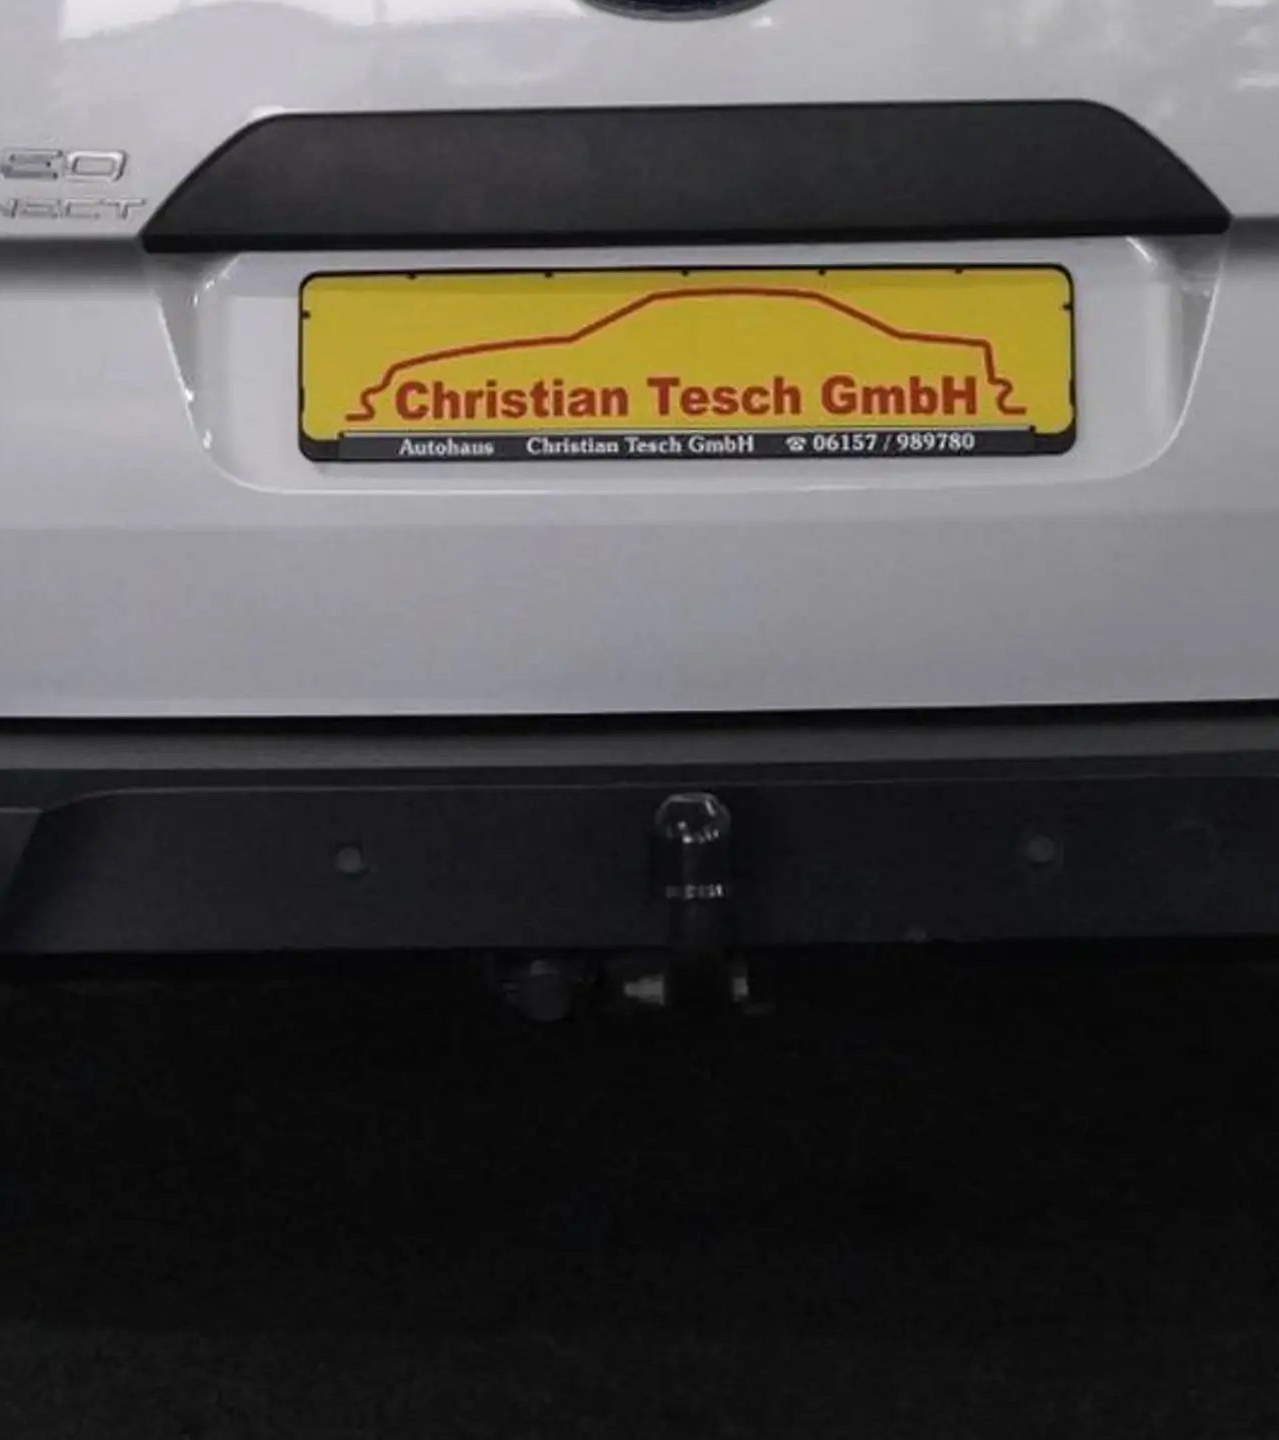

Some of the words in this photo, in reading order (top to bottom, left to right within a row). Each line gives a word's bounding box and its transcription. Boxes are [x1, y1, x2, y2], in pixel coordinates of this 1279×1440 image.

[395, 379, 629, 421] Christian
[646, 376, 802, 417] Tesch
[821, 375, 978, 416] GmbH
[398, 438, 496, 457] Autohaus
[525, 436, 620, 456] Christian
[626, 436, 683, 454] Tesch
[687, 434, 755, 454] GmbH
[812, 433, 877, 453] 06157
[895, 431, 976, 451] 989780
